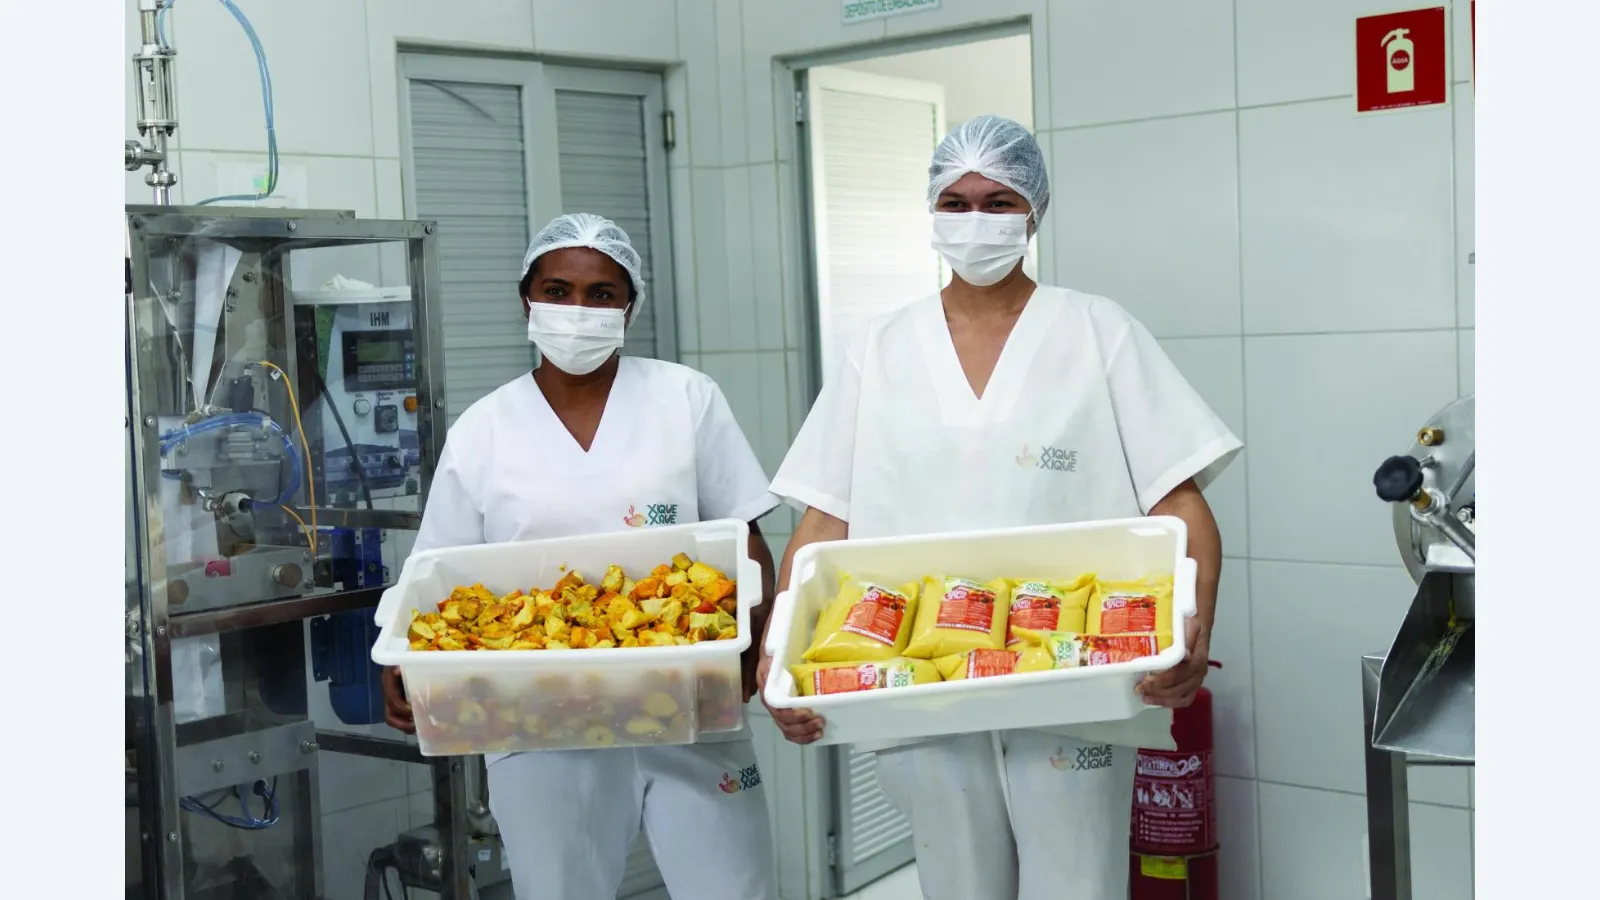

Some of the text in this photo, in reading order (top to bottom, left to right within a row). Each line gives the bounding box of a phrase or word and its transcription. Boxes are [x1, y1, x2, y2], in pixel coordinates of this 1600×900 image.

[370, 312, 390, 327] IHM
[1041, 446, 1078, 461] XIQUE
[1040, 458, 1077, 472] XIQUE
[647, 503, 678, 514] XIQUE
[1076, 744, 1112, 759] XIQUE
[1075, 756, 1112, 771] XIQUE
